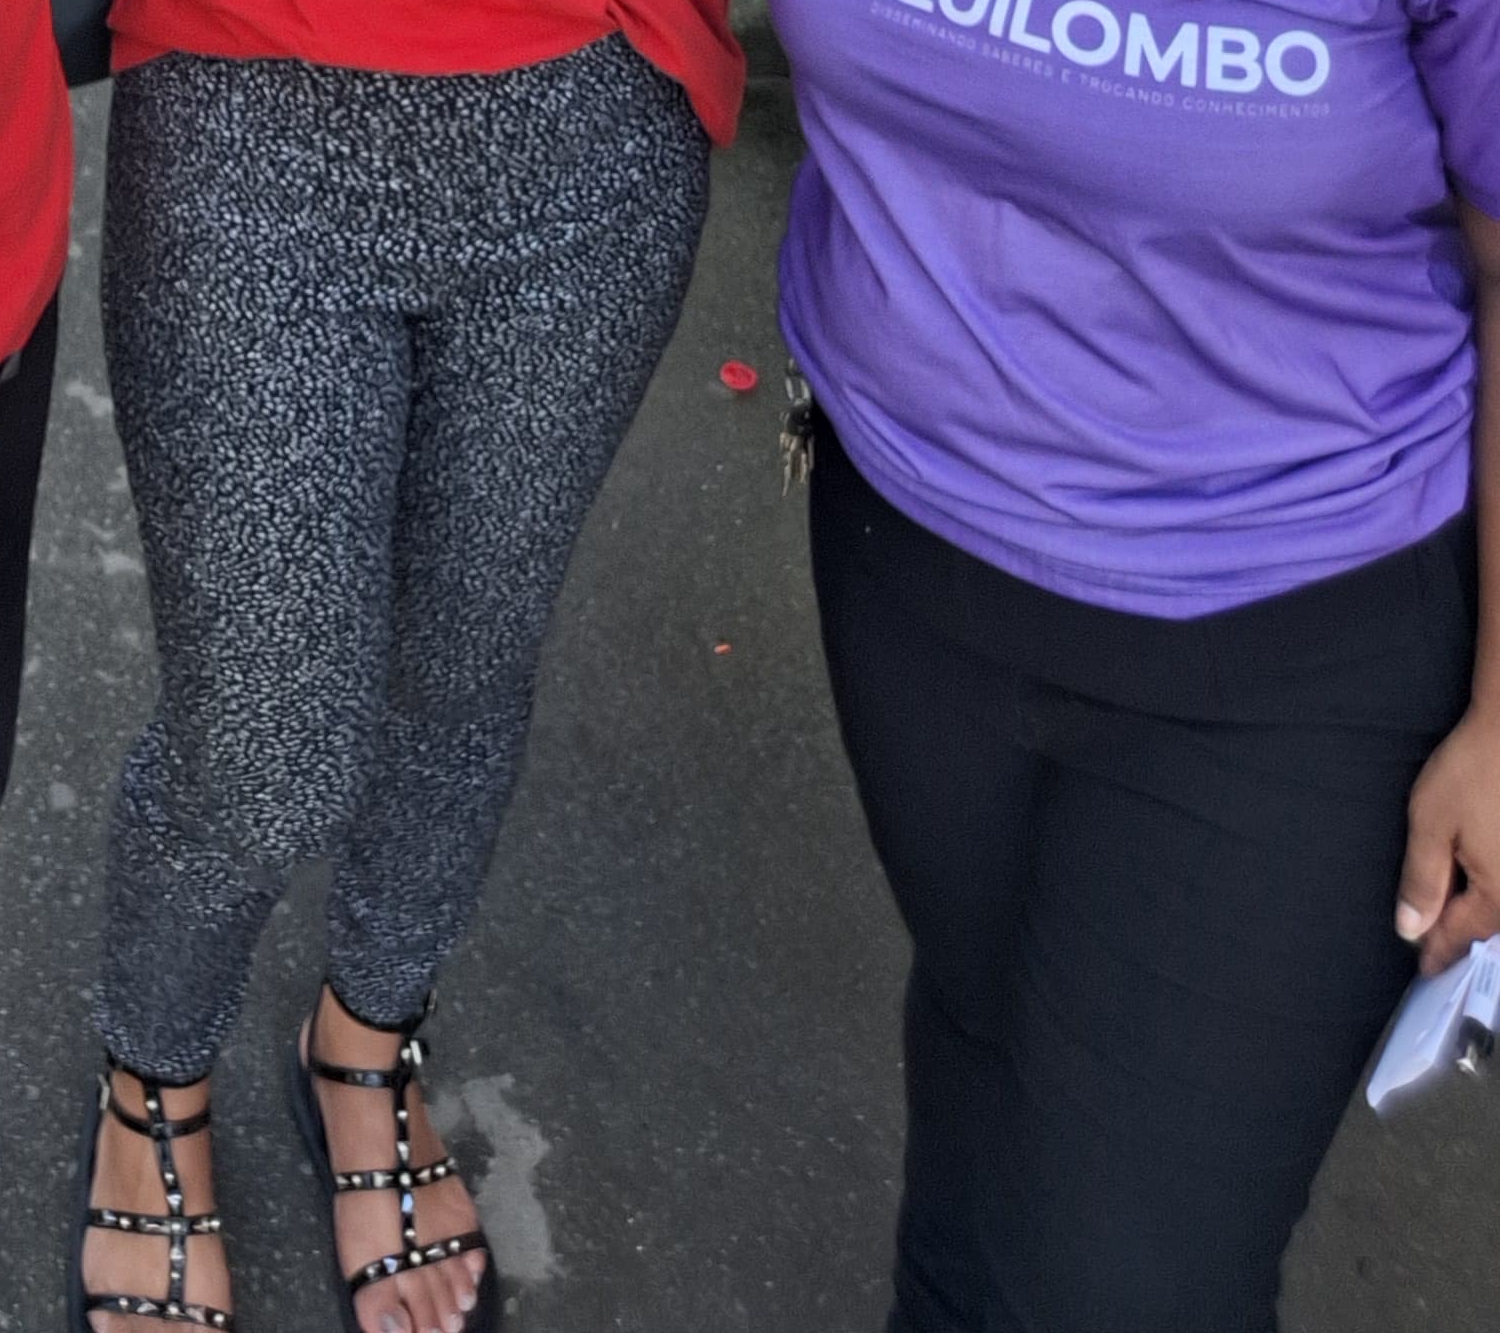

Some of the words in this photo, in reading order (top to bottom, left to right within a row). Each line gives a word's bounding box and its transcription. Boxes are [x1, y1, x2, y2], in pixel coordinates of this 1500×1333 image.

[870, 1, 977, 50] DISSEMINANDO
[981, 42, 1053, 77] SABERES
[1061, 68, 1071, 84] E
[1080, 72, 1175, 107] TROCANDO
[1182, 97, 1331, 119] CONHECIMENTOS
